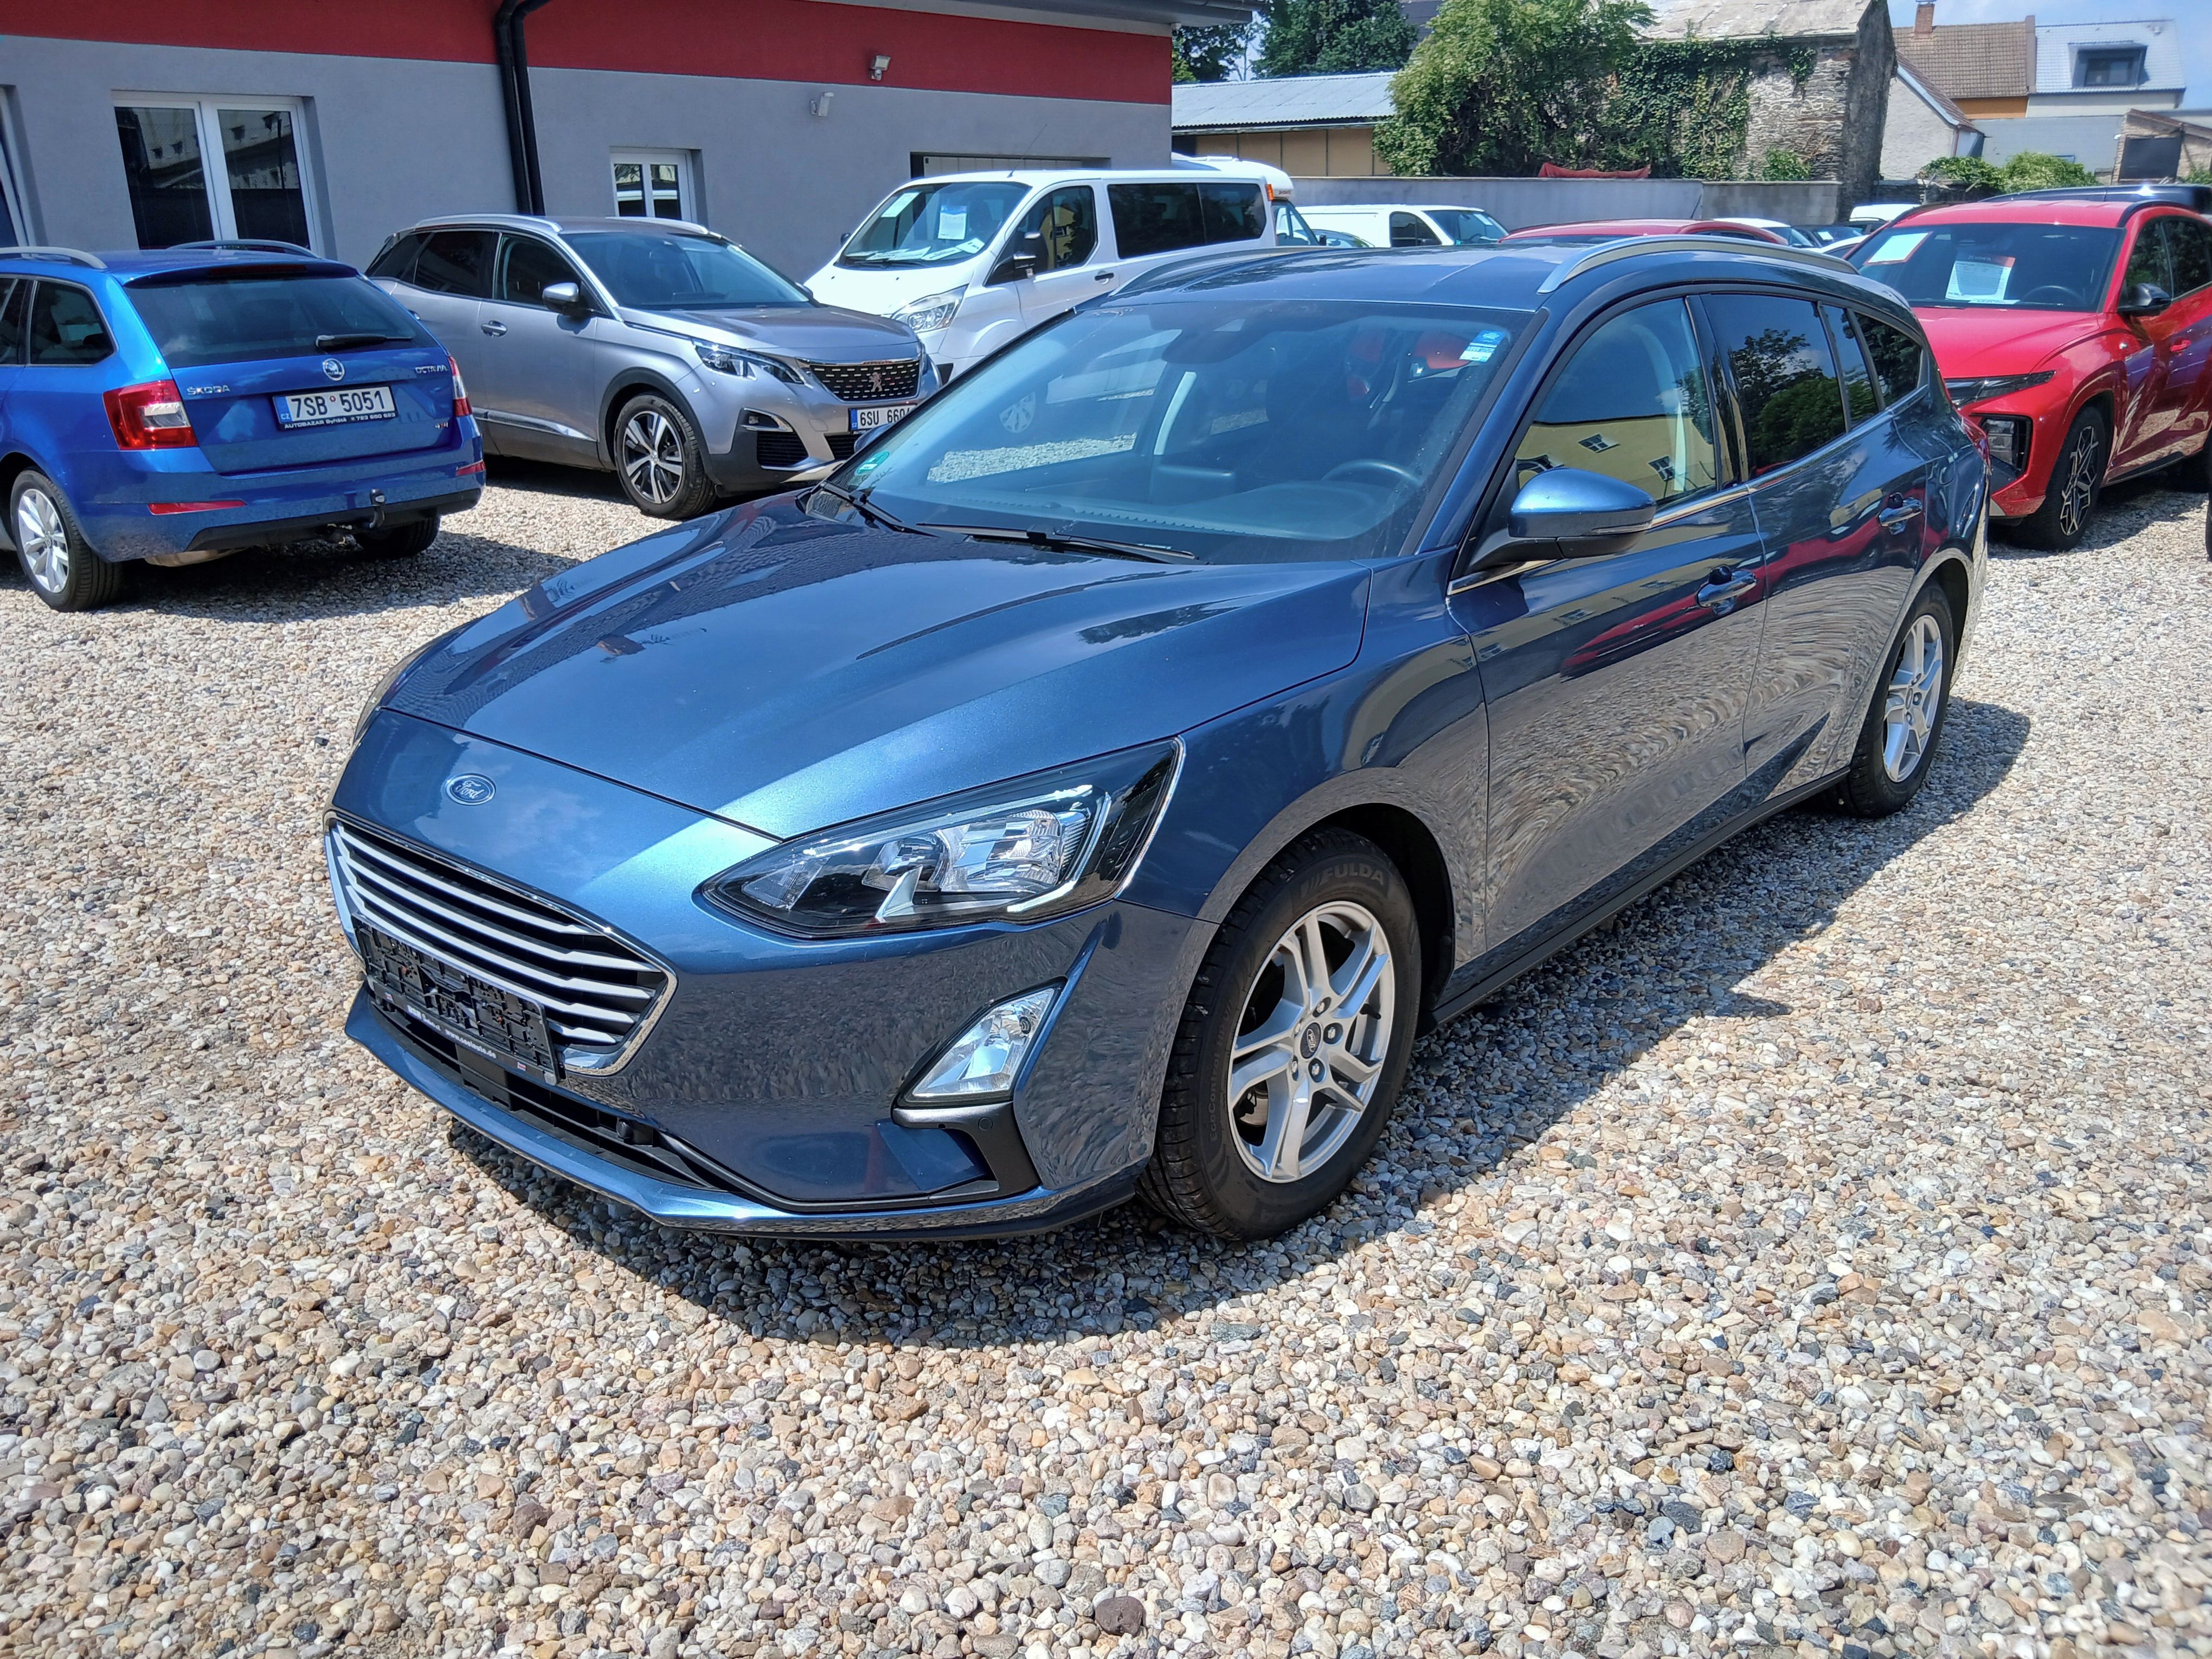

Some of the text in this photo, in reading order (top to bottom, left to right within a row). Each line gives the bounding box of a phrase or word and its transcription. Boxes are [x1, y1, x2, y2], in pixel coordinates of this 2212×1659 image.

[187, 384, 230, 395] ŠKODA
[291, 390, 385, 419] 7SB 5051
[285, 420, 324, 429] AUTOBAZAR
[860, 408, 910, 426] 6SU 660
[455, 780, 485, 799] Ford
[1320, 863, 1384, 886] FULDA
